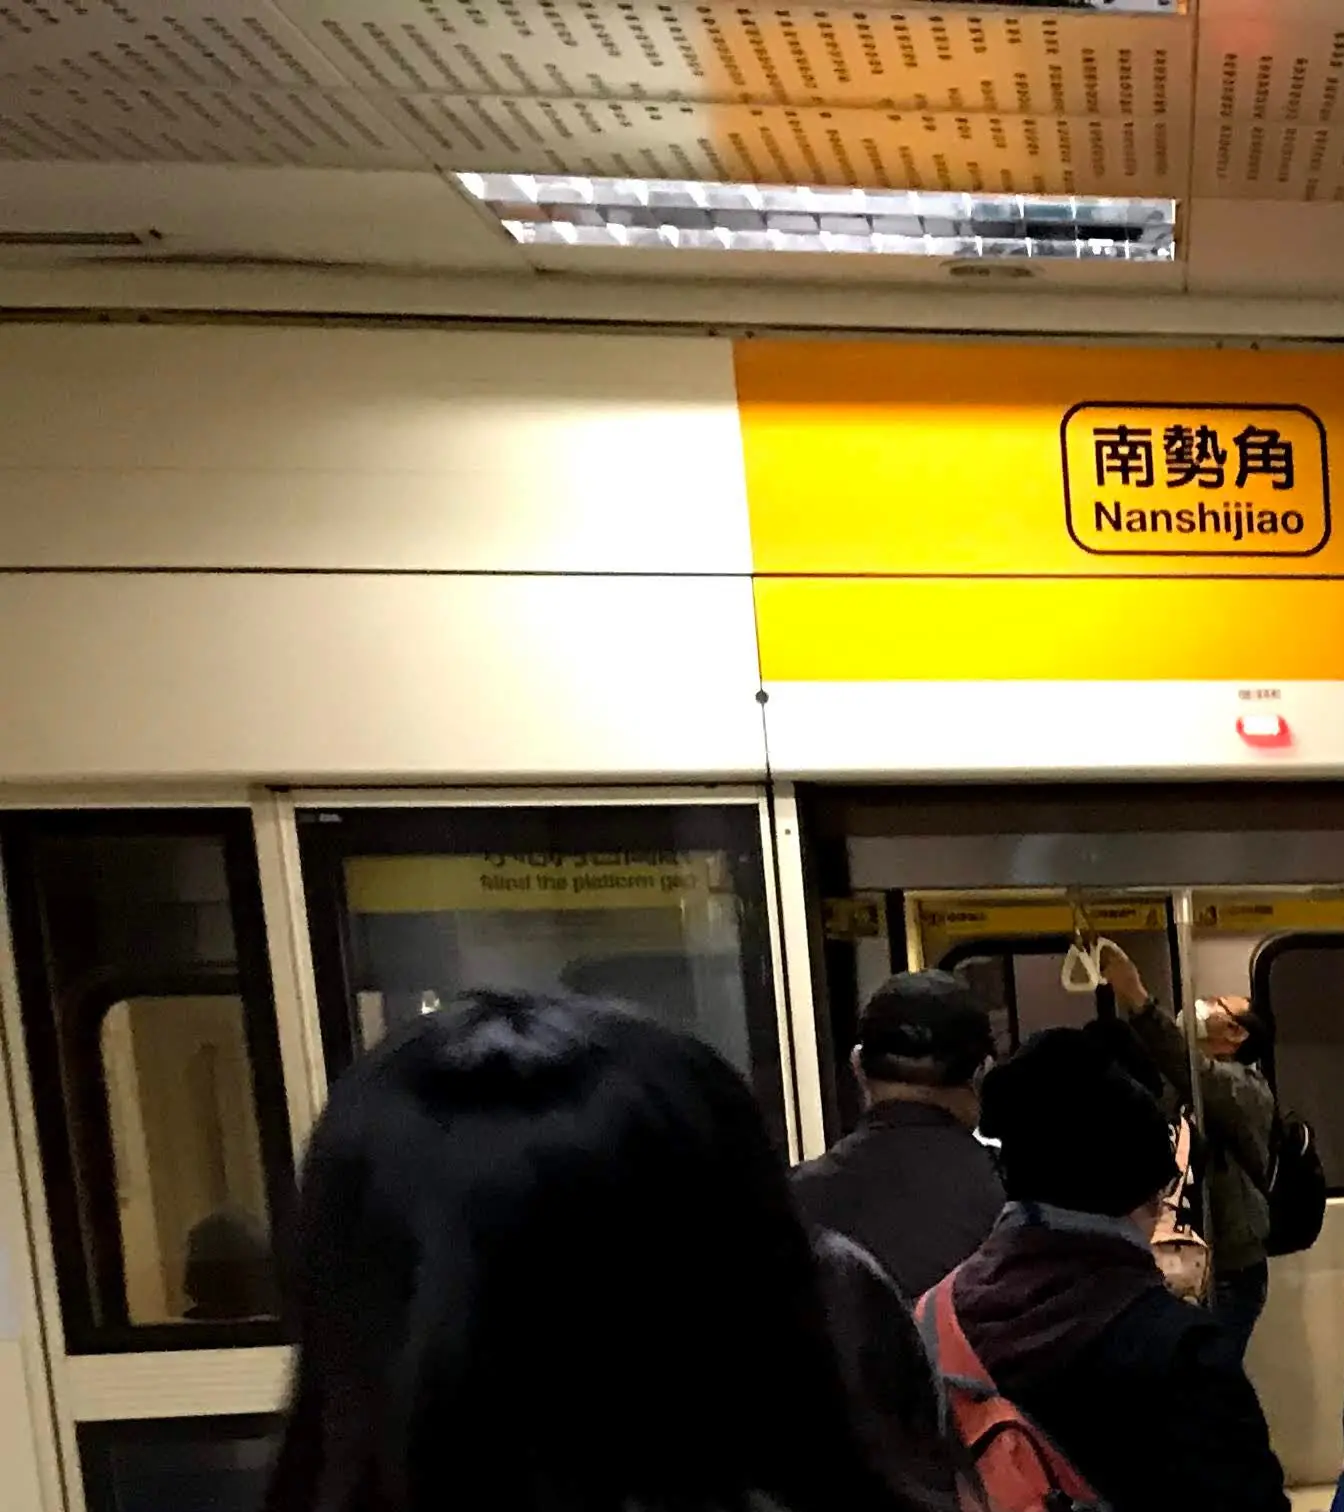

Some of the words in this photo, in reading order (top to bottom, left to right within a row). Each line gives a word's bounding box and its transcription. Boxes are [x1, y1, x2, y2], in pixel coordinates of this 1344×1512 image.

[1093, 424, 1294, 490] 南勢角
[1094, 501, 1304, 541] Nanshijiao
